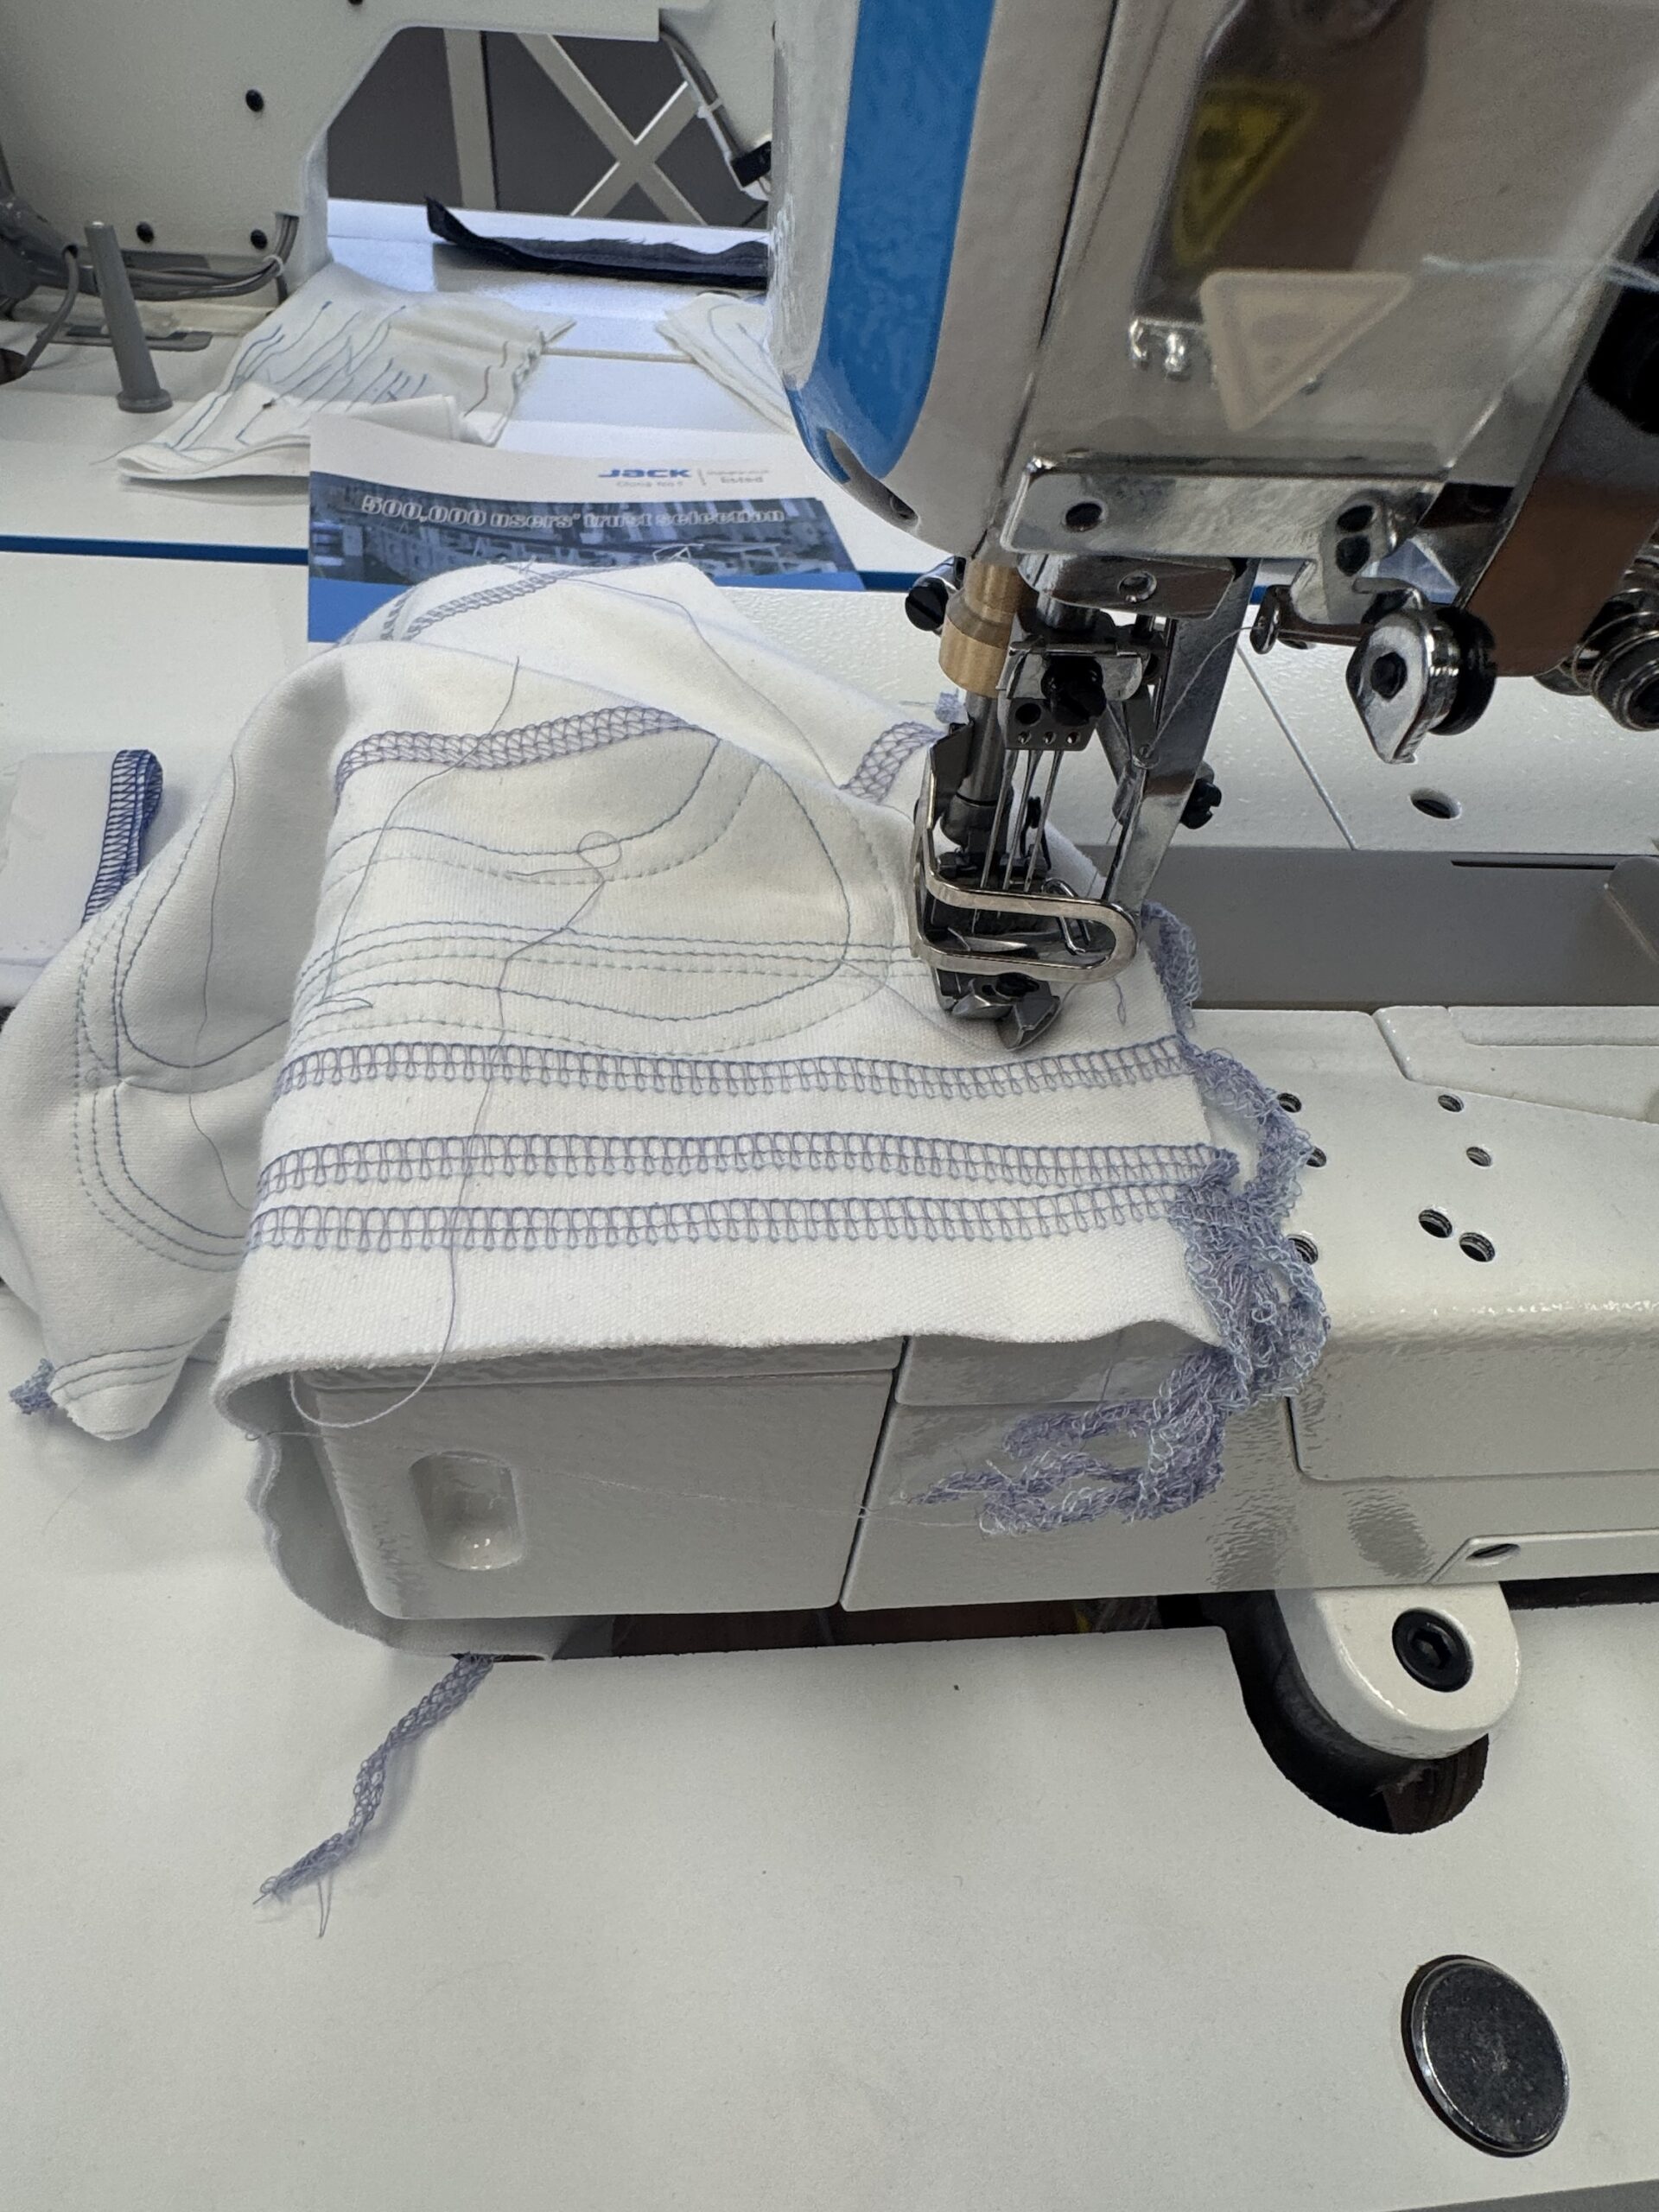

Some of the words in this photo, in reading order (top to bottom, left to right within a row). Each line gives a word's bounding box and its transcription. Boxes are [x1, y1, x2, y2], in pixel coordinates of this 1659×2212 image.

[361, 494, 486, 526] 500,000
[582, 510, 652, 528] trust
[655, 510, 785, 527] selection
